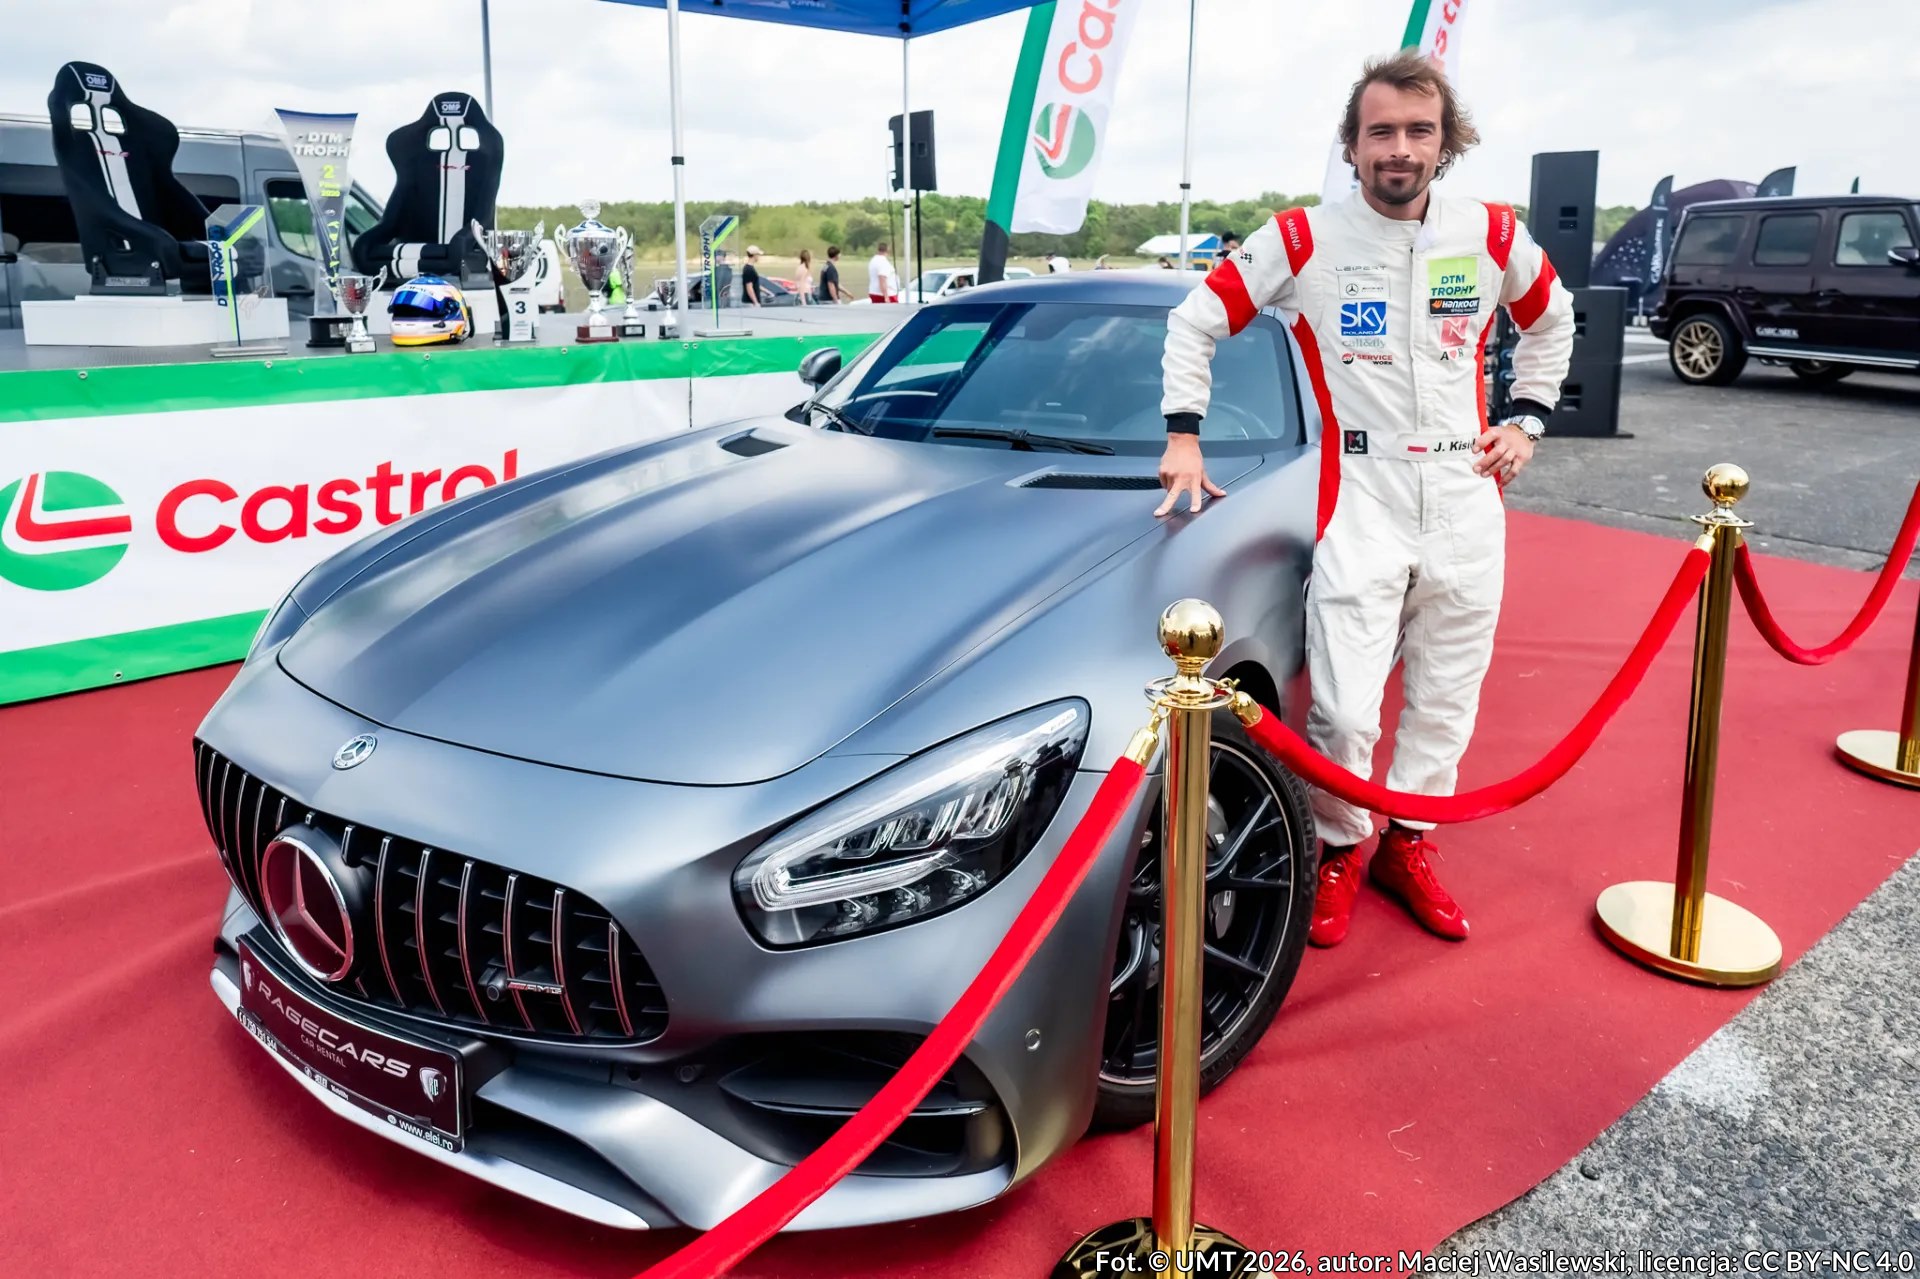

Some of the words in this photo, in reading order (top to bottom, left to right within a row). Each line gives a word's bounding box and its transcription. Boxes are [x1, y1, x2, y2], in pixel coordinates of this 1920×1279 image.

[1058, 0, 1120, 94] Ca
[442, 104, 461, 112] OMP
[307, 132, 342, 144] DTM
[294, 143, 350, 157] TROPH
[702, 229, 711, 272] TROPHY
[1441, 275, 1465, 284] DTM
[1431, 285, 1475, 296] TROPHY
[515, 301, 526, 314] 3
[1434, 442, 1445, 452] J.
[259, 980, 411, 1078] RAGECARS
[300, 1034, 315, 1050] CAR
[316, 1044, 347, 1068] RENTAL
[399, 1119, 453, 1151] www.elei.ro
